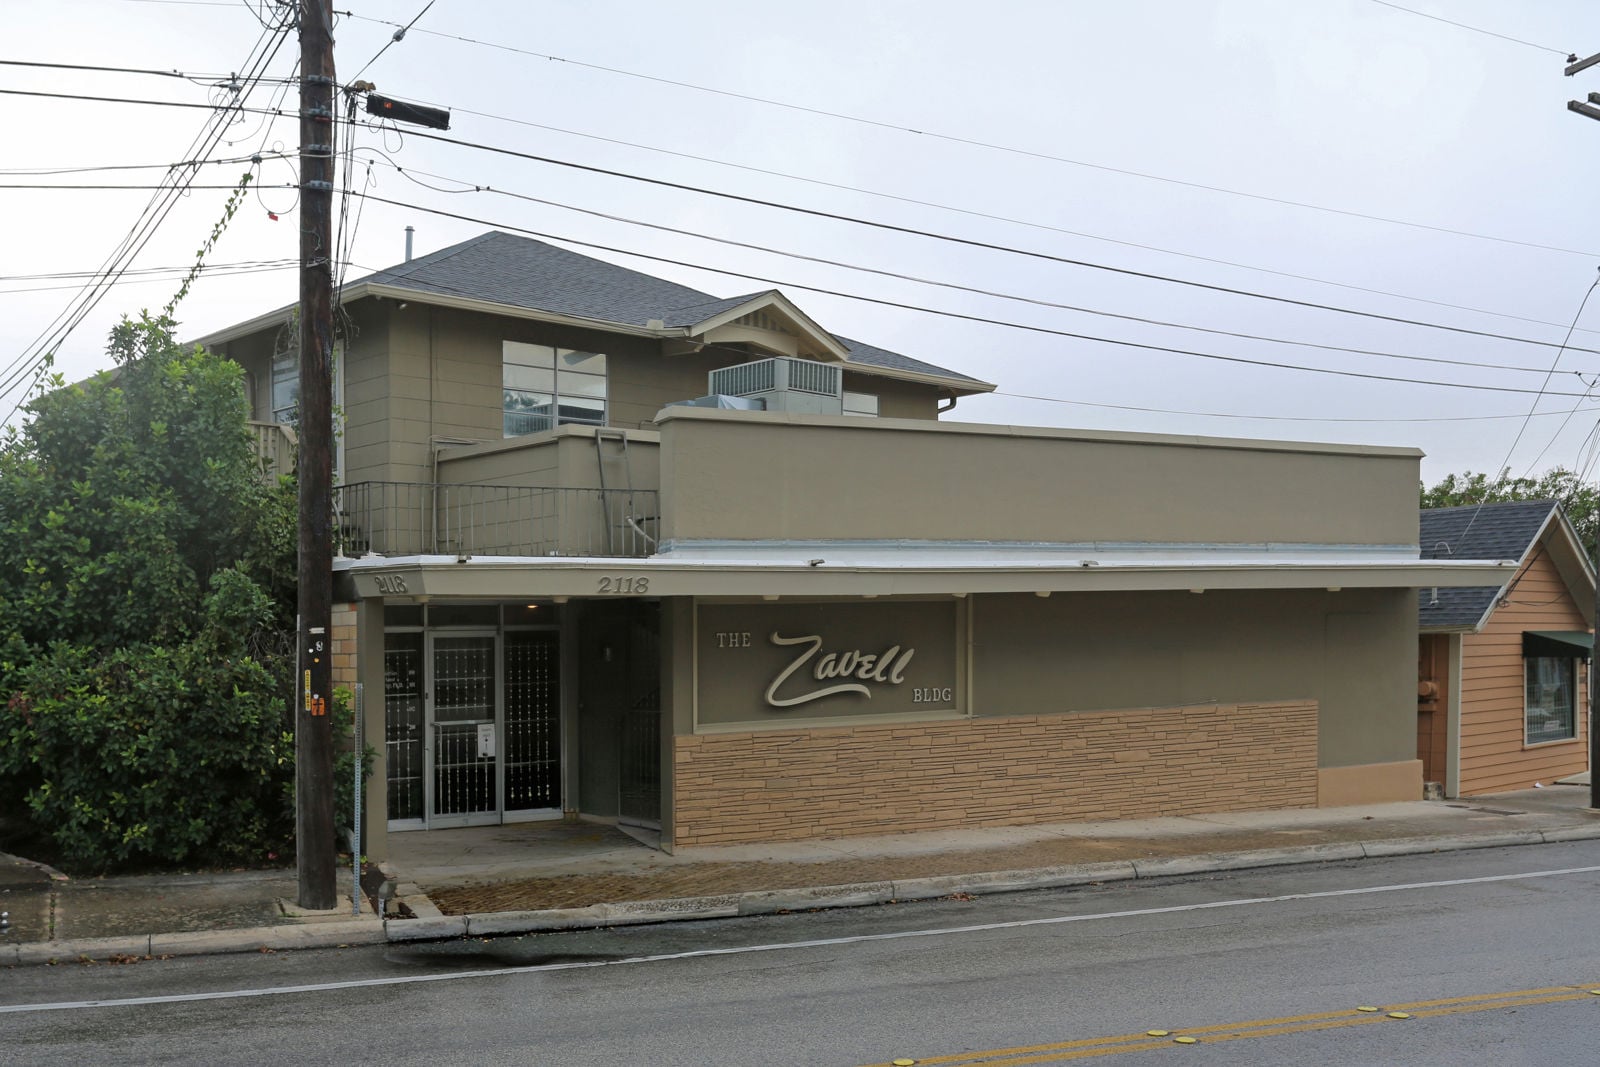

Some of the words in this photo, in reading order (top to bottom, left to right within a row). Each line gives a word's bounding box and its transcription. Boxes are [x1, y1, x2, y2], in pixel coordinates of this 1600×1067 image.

[374, 575, 408, 594] 2118
[597, 576, 650, 594] 2118
[716, 632, 751, 648] THE
[764, 632, 915, 707] Zavell
[912, 688, 952, 703] BLDG
